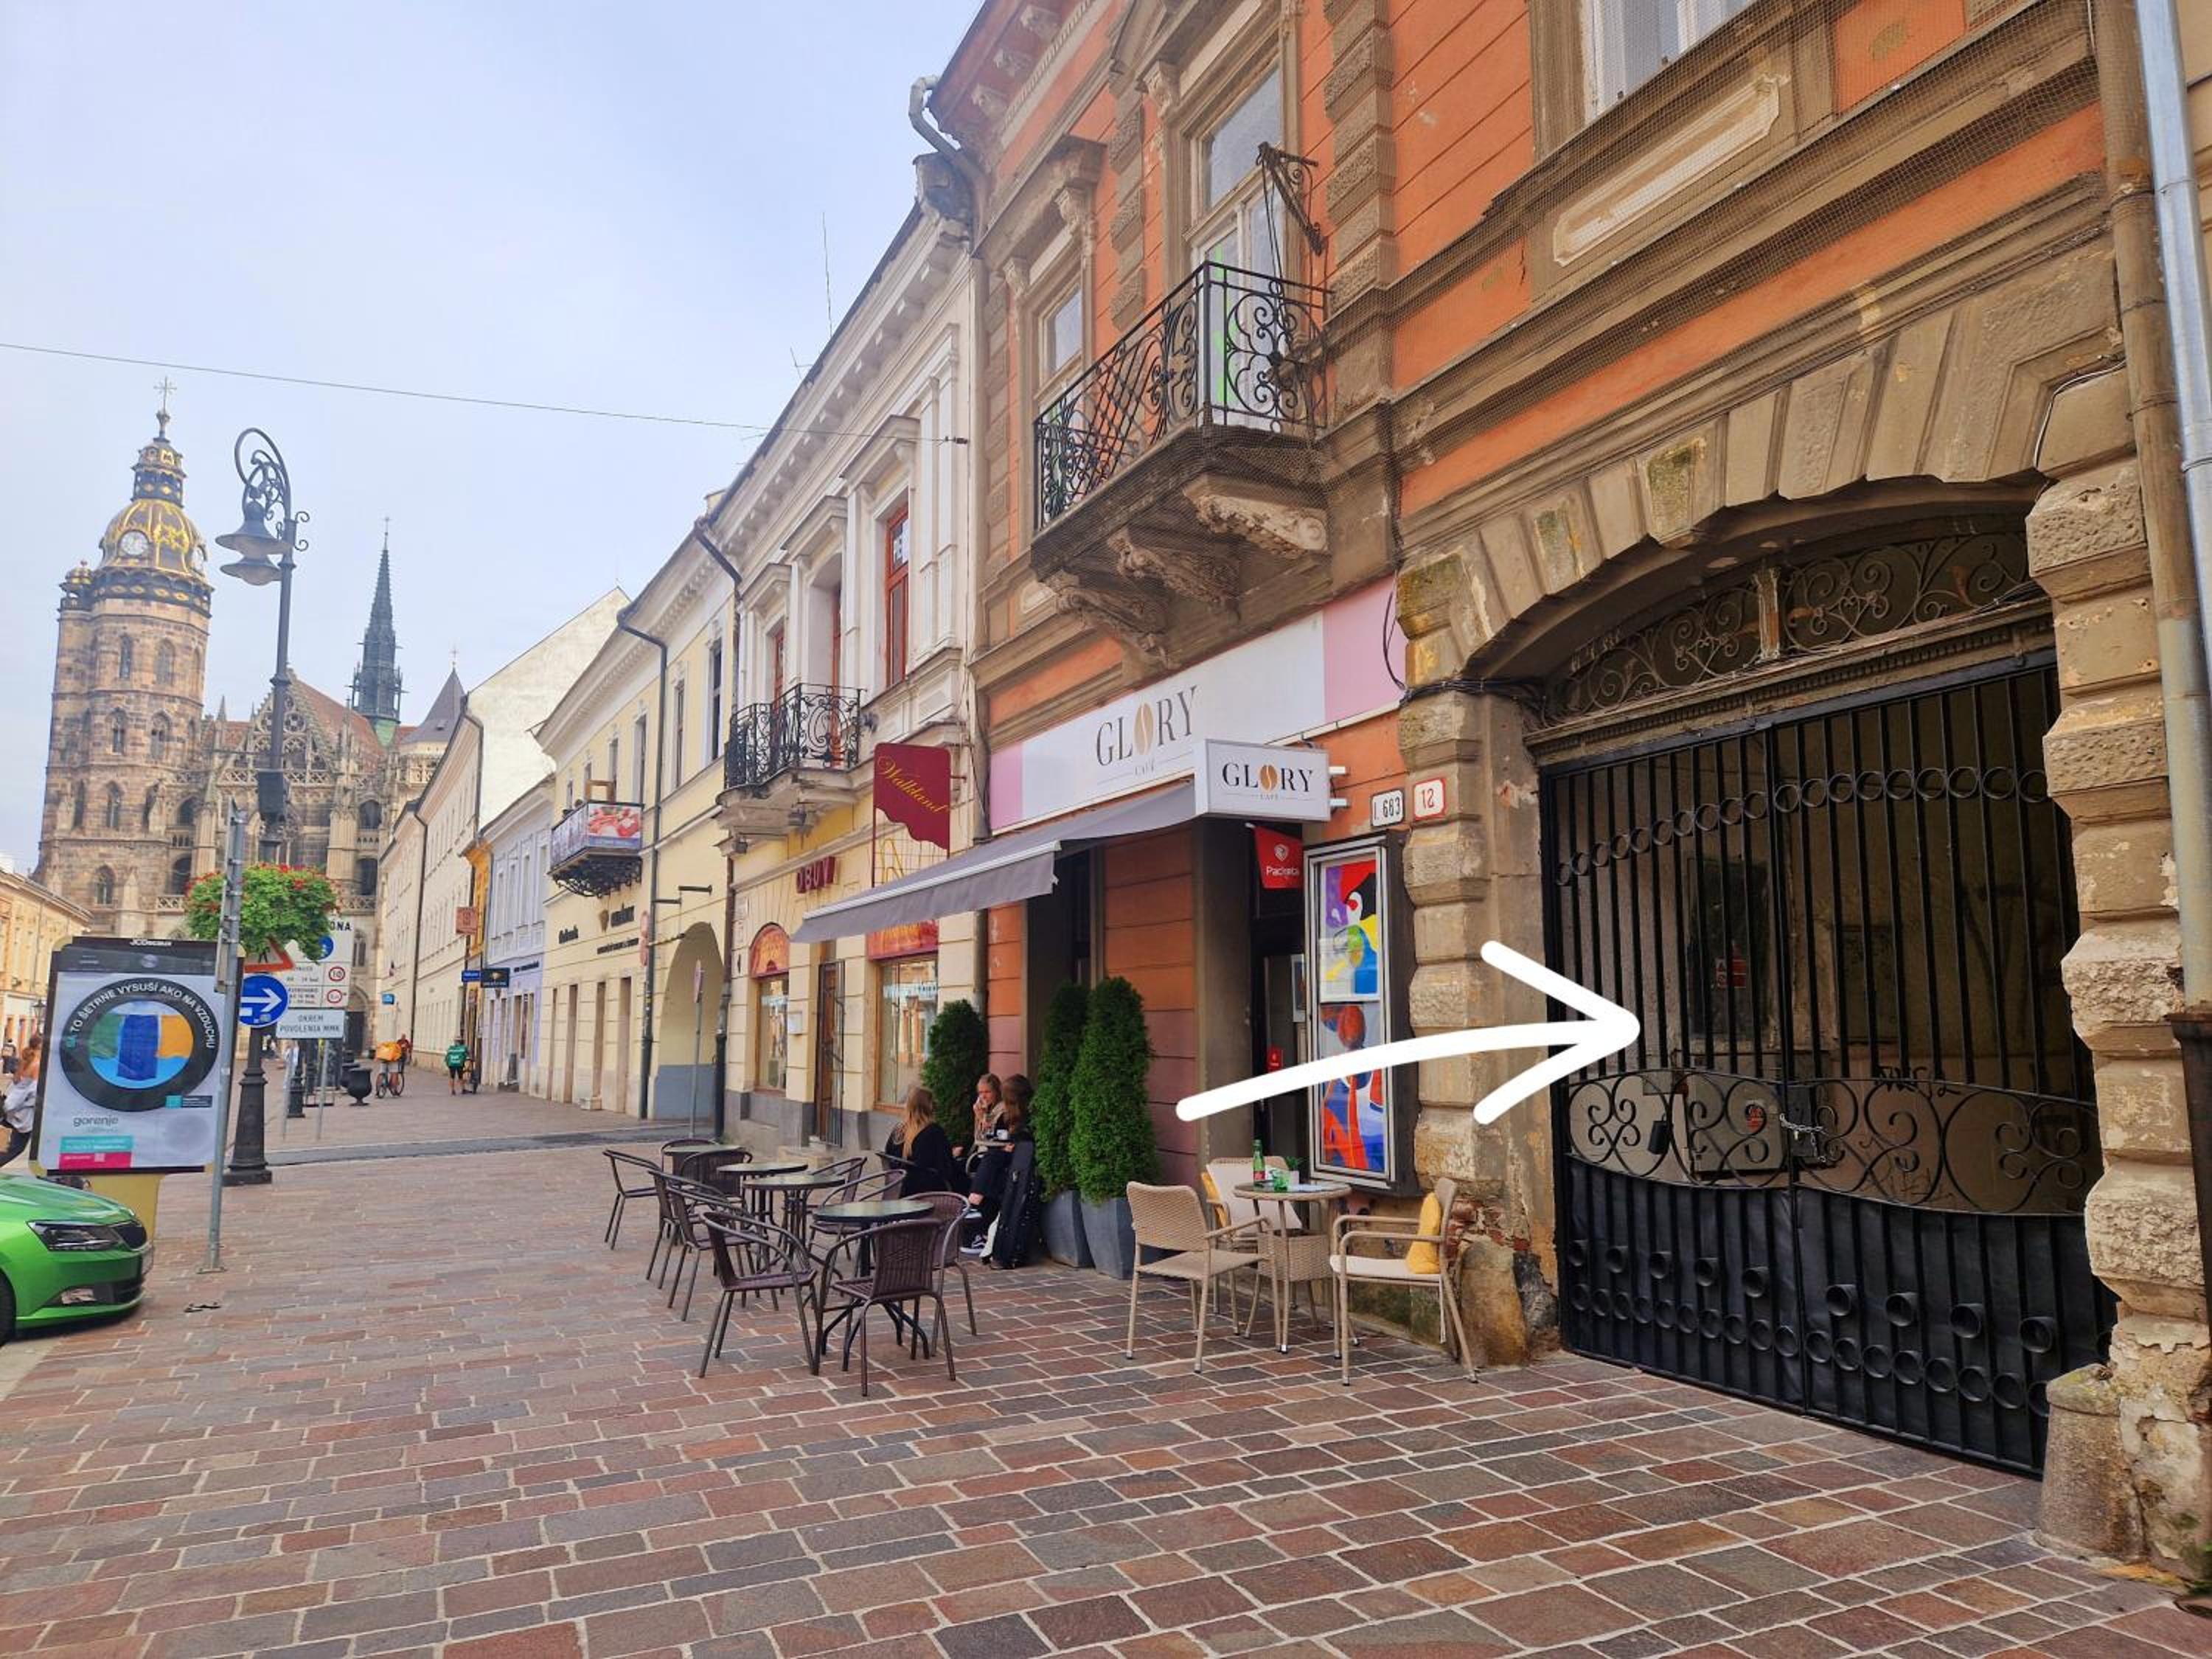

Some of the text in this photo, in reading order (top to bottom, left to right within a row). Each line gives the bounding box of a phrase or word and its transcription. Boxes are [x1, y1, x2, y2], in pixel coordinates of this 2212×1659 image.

[1096, 685, 1196, 766] GLORY
[1222, 762, 1313, 793] GLORY
[1382, 796, 1400, 818] 683
[1422, 788, 1434, 809] 12
[797, 856, 835, 894] OBUV
[70, 1020, 83, 1032] TO
[117, 981, 159, 995] VYSUŠÍ
[159, 985, 182, 998] AKO
[182, 995, 197, 1008] NA
[195, 1005, 216, 1048] VZDUCHU
[73, 1115, 119, 1127] gorenje
